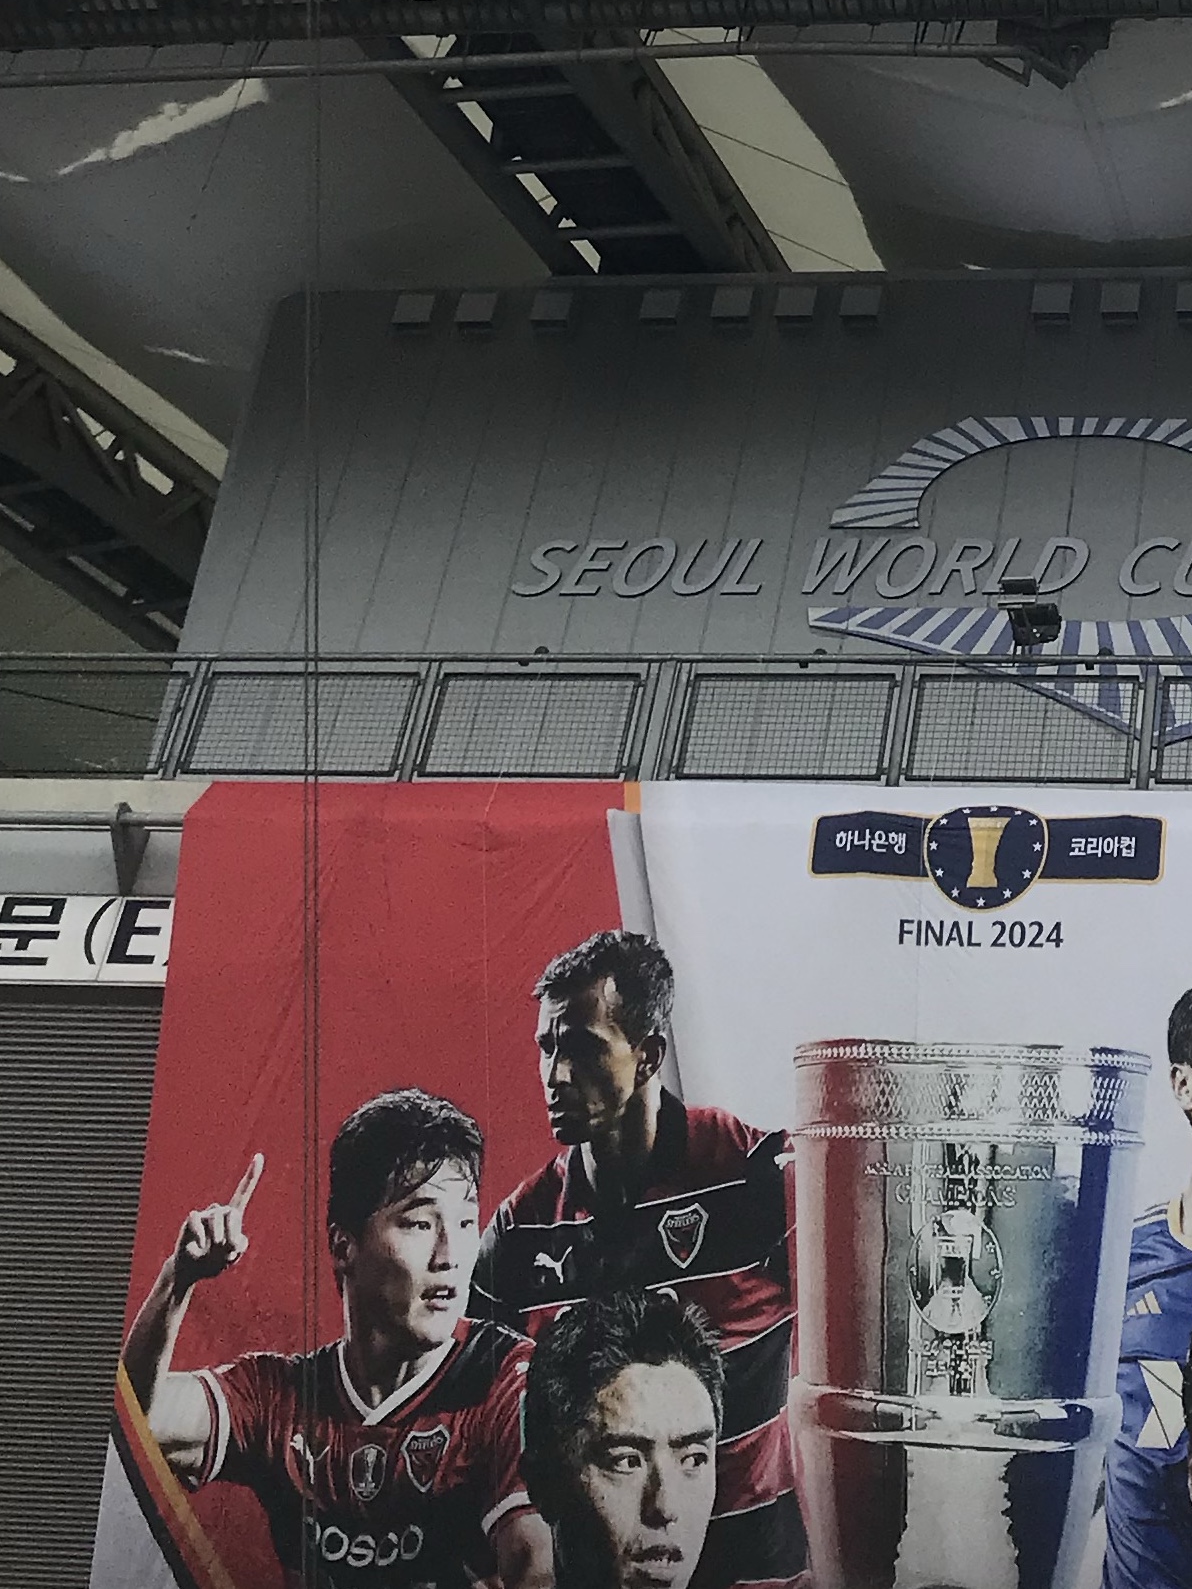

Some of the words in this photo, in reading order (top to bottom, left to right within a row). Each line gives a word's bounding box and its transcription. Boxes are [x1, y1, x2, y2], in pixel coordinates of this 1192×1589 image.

[510, 537, 765, 598] SEOUL
[801, 536, 1091, 599] WORLD
[835, 829, 907, 855] 하나은행
[1069, 835, 1136, 858] 코리아컵
[0, 896, 169, 967] 문(E
[898, 918, 982, 948] FINAL
[989, 920, 1064, 949] 2024
